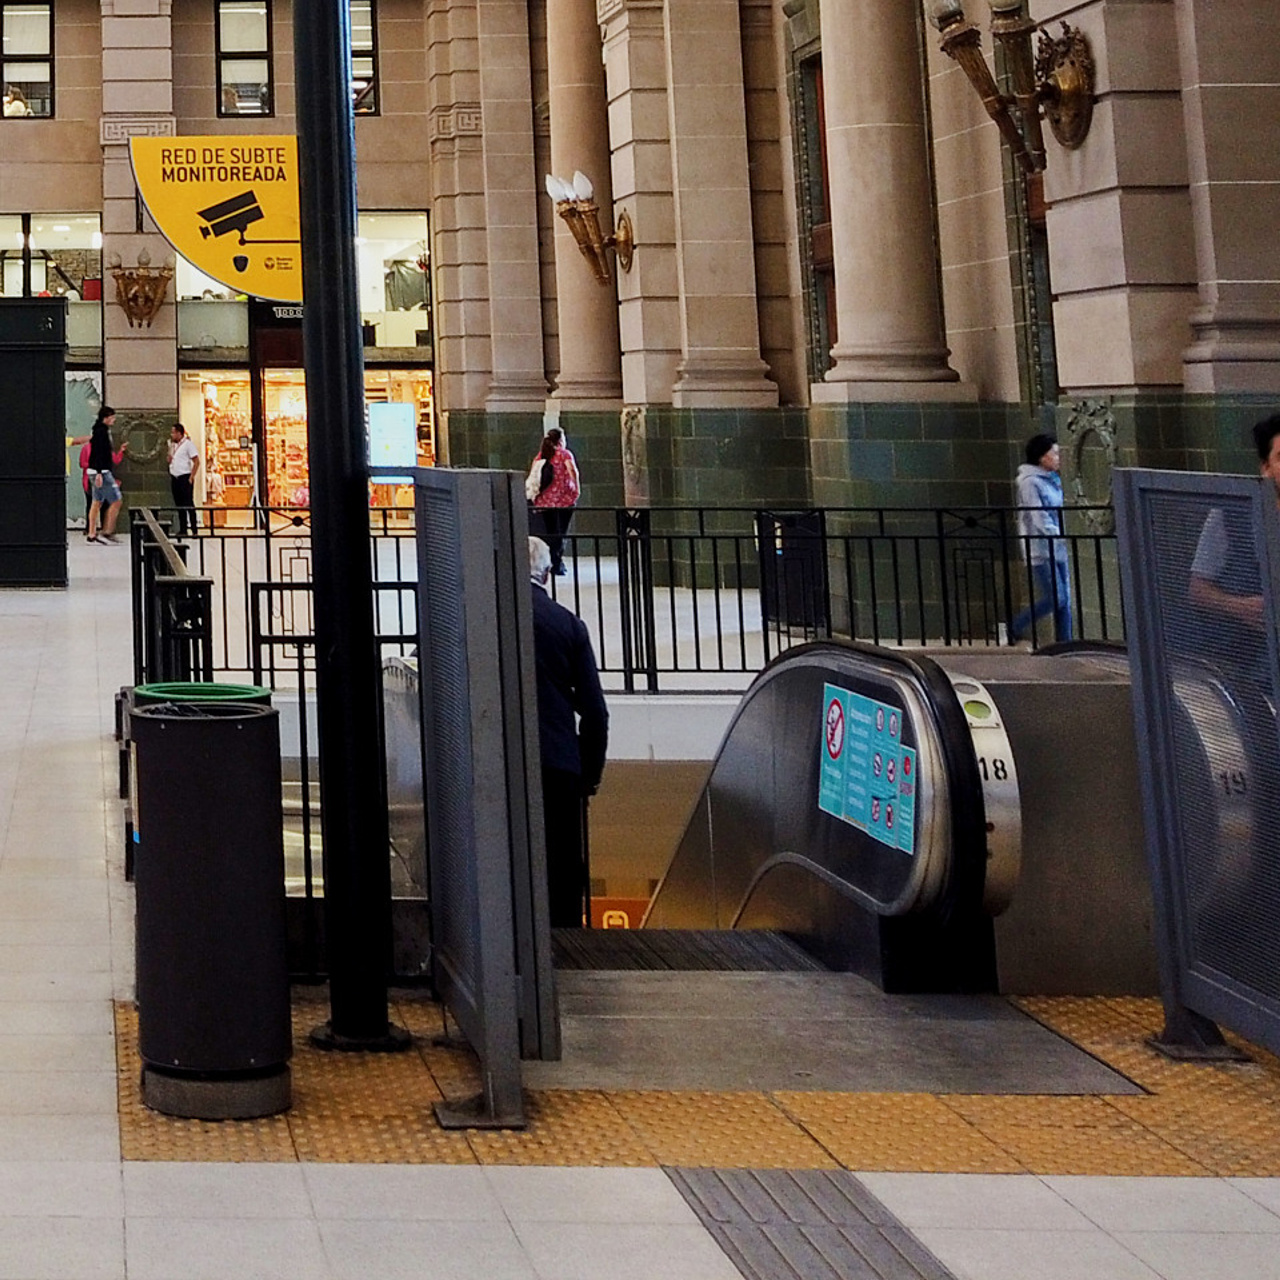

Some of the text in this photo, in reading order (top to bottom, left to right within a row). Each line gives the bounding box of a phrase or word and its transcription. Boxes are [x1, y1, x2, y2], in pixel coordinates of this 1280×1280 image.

[161, 147, 286, 165] RED DE SUBTE
[161, 166, 287, 183] MONITOREADA
[979, 756, 1008, 781] 18
